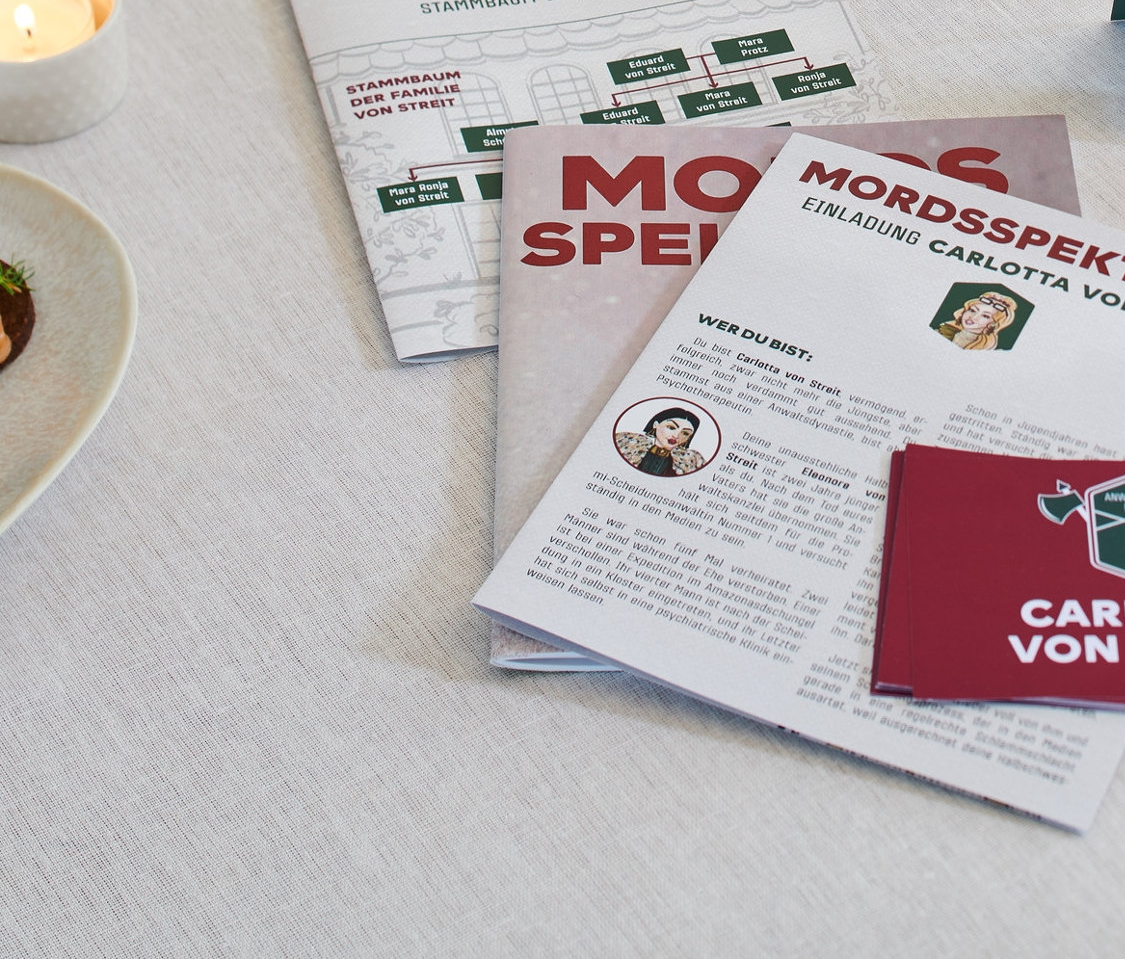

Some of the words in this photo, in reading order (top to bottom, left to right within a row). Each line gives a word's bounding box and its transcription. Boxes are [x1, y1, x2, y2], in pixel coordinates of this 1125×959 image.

[738, 37, 763, 48] Mara
[741, 45, 768, 57] Protz
[625, 68, 645, 79] von
[647, 62, 677, 75] Streit
[629, 55, 664, 68] Eduard
[346, 71, 461, 94] STAMMBAUM
[791, 84, 811, 94] von
[813, 77, 842, 90] Streit
[798, 70, 826, 84] Ronja
[350, 95, 385, 107] DER
[391, 84, 461, 100] FAMILIE
[696, 101, 716, 112] von
[718, 96, 748, 108] Streit
[705, 90, 730, 100] Mara
[354, 106, 393, 120] VON
[398, 98, 455, 112] STREIT
[602, 107, 639, 120] Eduard
[389, 186, 416, 197] Mara
[419, 180, 449, 192] Ronja
[395, 197, 415, 206] von
[418, 191, 449, 203] Streit
[801, 197, 921, 245] EINLADUNG
[928, 238, 1070, 292] CARLOTTA
[699, 313, 740, 335] WER
[741, 329, 769, 344] DU
[769, 339, 813, 362] BIST:
[694, 338, 707, 347] Du
[712, 343, 731, 356] bist
[737, 353, 780, 374] Carlotta
[786, 372, 805, 383] von
[670, 354, 703, 370] immer
[712, 370, 736, 383] noch
[747, 382, 798, 407] verdammt
[807, 406, 825, 416] gut
[677, 344, 722, 367] folgreich,
[730, 364, 756, 377] zwar
[761, 375, 787, 390] nicht
[793, 388, 820, 401] mehr
[826, 399, 842, 409] die
[899, 423, 922, 435] aber
[663, 365, 709, 386] stammst
[714, 383, 733, 394] aus
[737, 392, 764, 406] einer
[861, 435, 882, 449] bist
[743, 432, 771, 448] Deine
[778, 447, 857, 479] unausstehliche
[726, 452, 758, 470] Streit
[762, 465, 777, 477] ist
[781, 474, 807, 488] zwei
[811, 484, 841, 500] Jahre
[731, 442, 786, 467] schwester
[802, 467, 849, 489] Eleonore
[866, 490, 885, 501] von
[712, 473, 746, 493] Vaters
[750, 488, 768, 501] hat
[773, 498, 788, 509] sie
[793, 505, 809, 516] die
[719, 464, 735, 475] als
[760, 479, 787, 495] Nach
[792, 491, 815, 504] dem
[821, 499, 839, 513] Tod
[843, 509, 873, 524] eures
[628, 497, 639, 507] in
[642, 503, 662, 516] den
[665, 511, 702, 531] Medien
[705, 527, 719, 537] zu
[698, 483, 765, 513] waltskanzlei
[843, 534, 861, 547] Sie
[1008, 634, 1119, 663] VON
